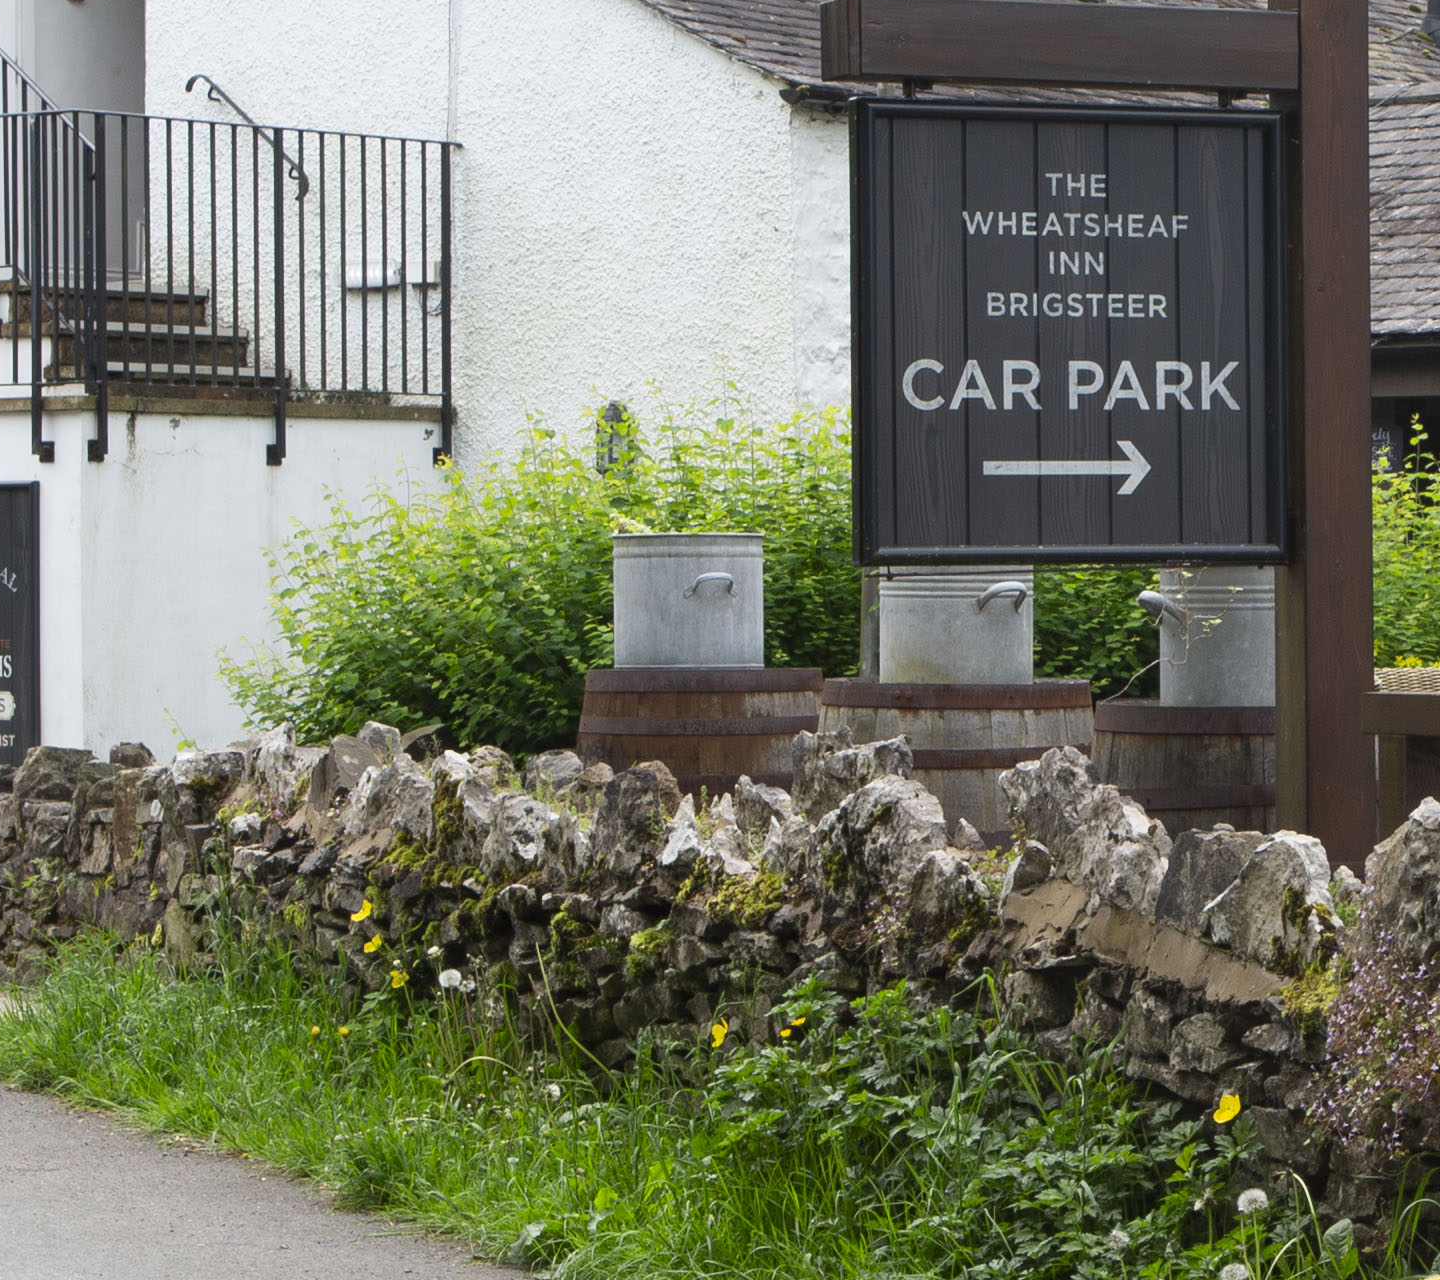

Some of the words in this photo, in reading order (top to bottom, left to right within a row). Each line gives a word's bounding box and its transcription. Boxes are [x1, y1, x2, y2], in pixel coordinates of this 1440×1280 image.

[1045, 172, 1107, 198] THE
[962, 211, 1189, 239] WHEATSHEAF
[1049, 251, 1105, 276] INN
[986, 291, 1168, 319] BRIGSTEER
[902, 358, 1043, 411] CAR
[1067, 360, 1241, 411] PARK
